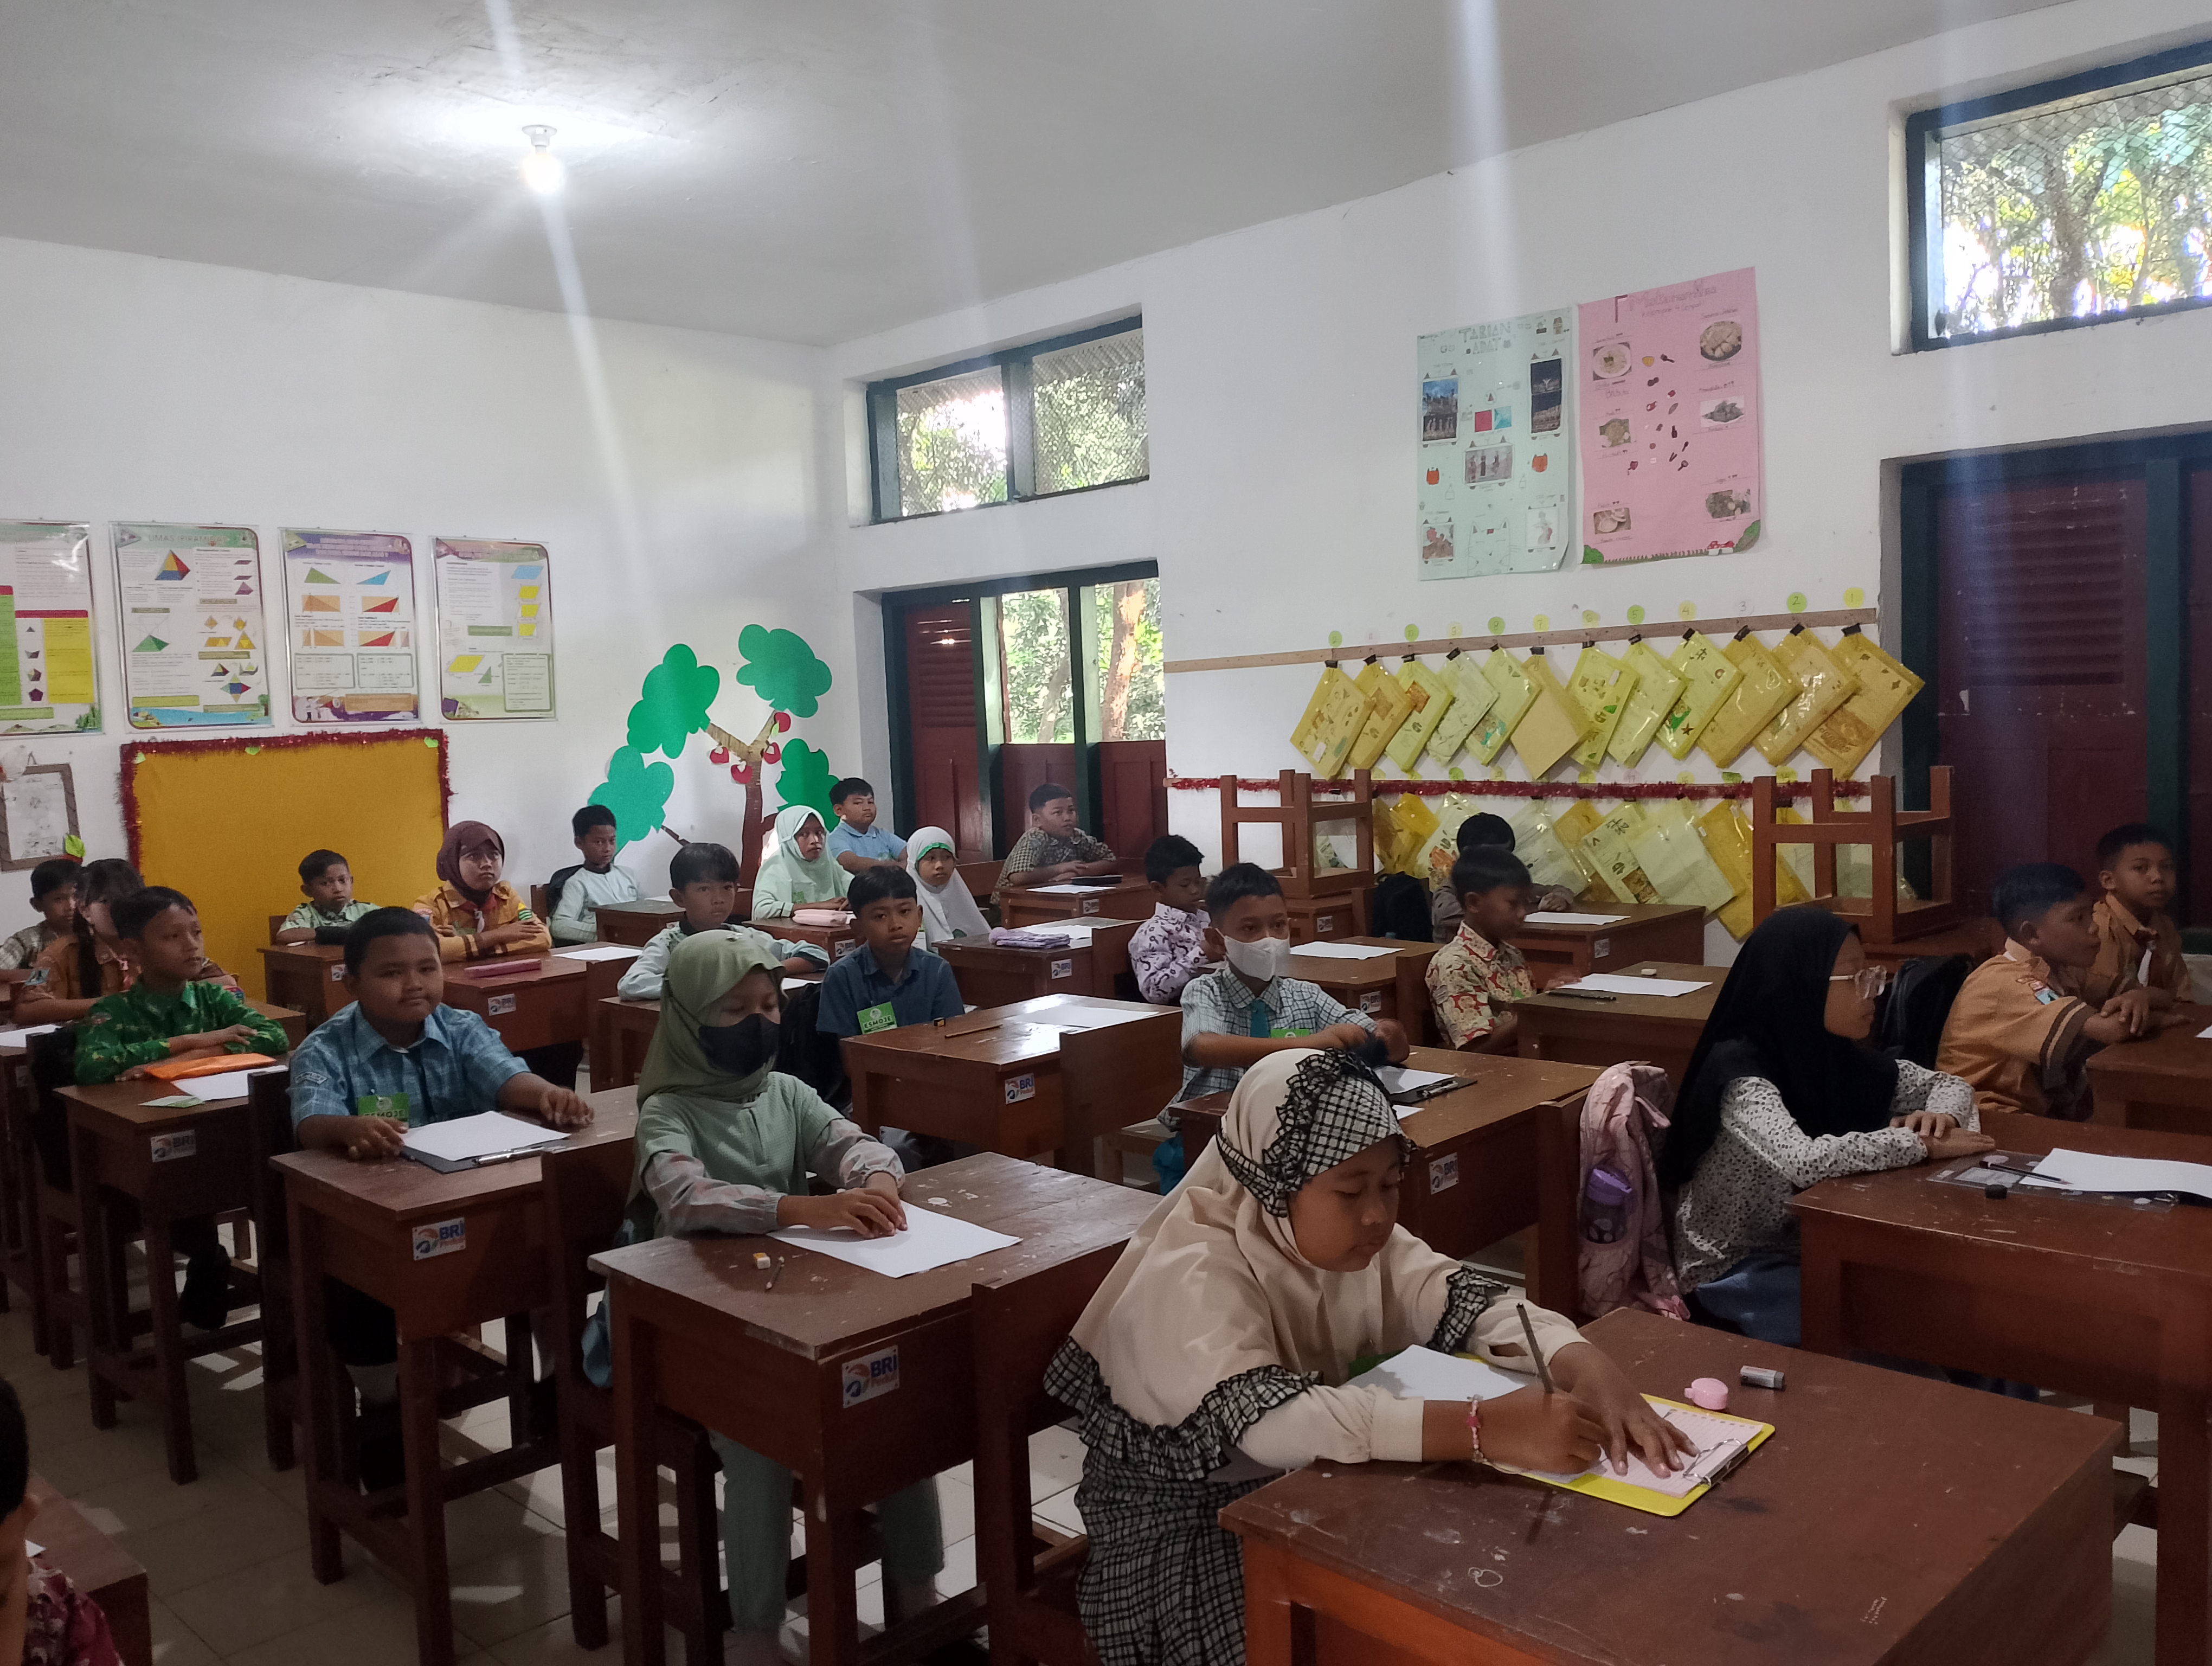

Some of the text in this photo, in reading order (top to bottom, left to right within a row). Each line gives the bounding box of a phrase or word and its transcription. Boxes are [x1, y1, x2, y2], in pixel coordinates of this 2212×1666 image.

[1792, 596, 1801, 606] 2
[1682, 606, 1690, 616] 4
[1740, 601, 1746, 612] 3
[1586, 614, 1593, 623] 6
[1632, 610, 1639, 619] 5
[1494, 621, 1499, 631] 8
[864, 1016, 892, 1029] ESMOJE
[1020, 1075, 1034, 1090] BRI
[440, 1222, 465, 1240] BRI
[871, 1354, 897, 1378] BRI
